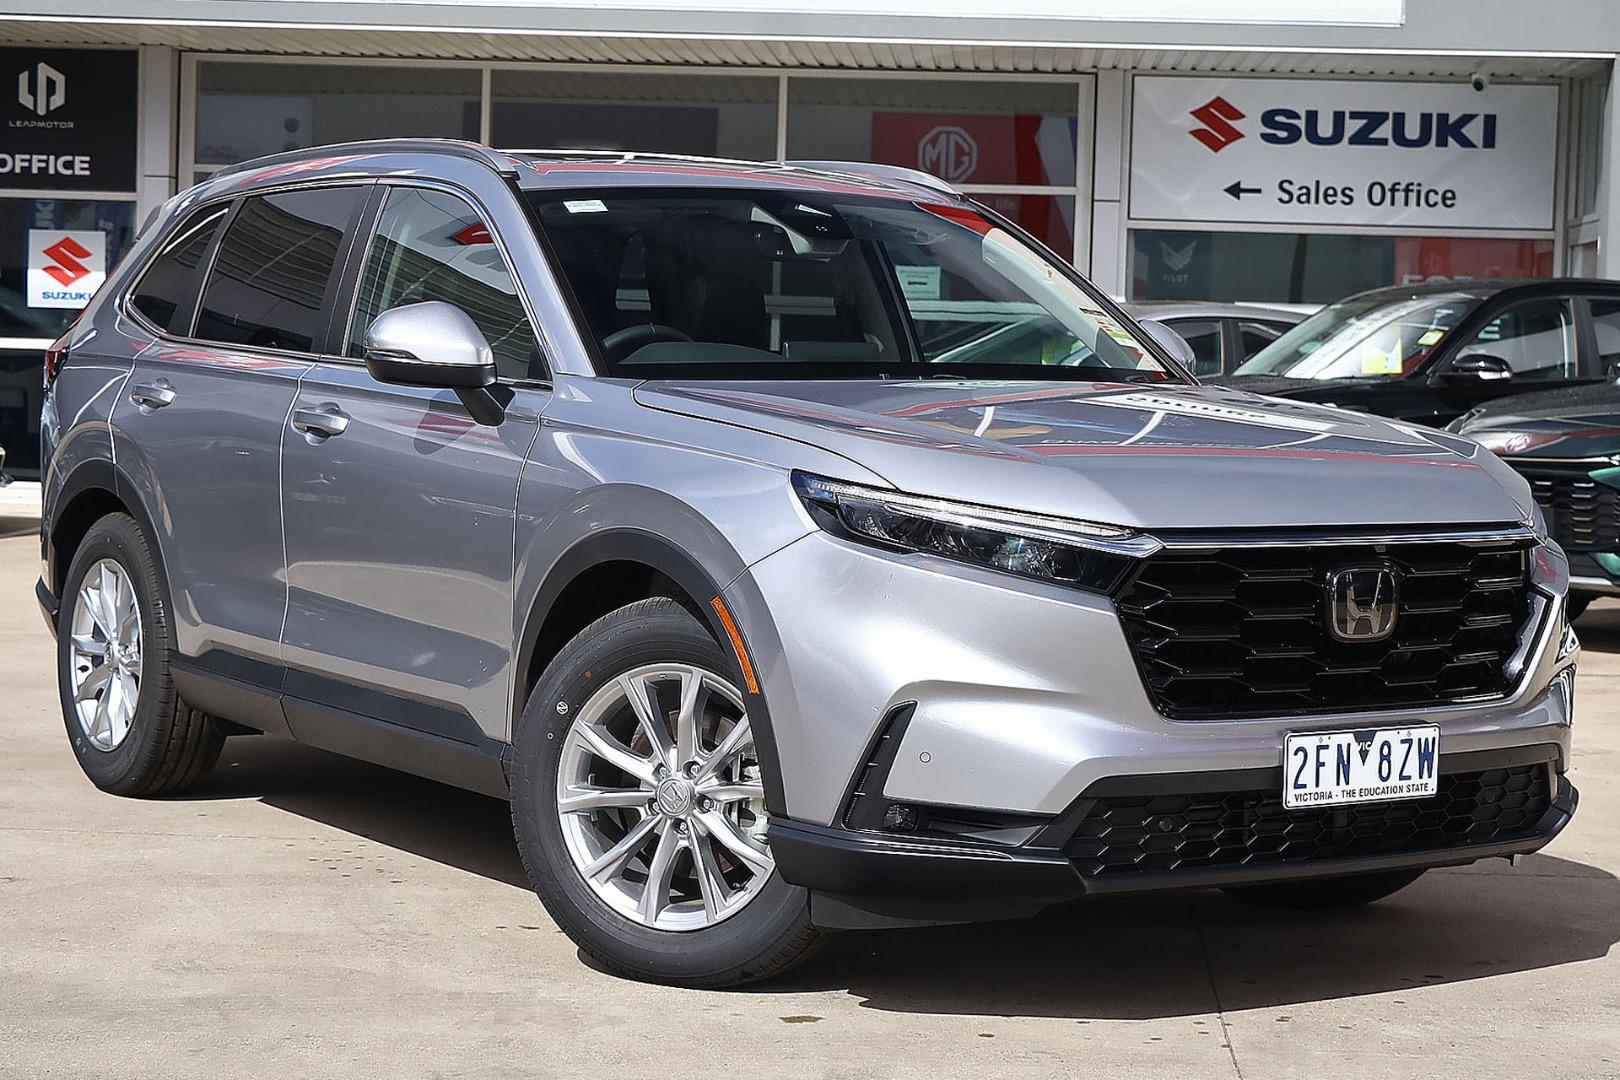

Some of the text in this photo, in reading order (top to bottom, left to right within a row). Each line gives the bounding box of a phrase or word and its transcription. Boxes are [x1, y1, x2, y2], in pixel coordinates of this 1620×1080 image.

[9, 120, 74, 128] LEAPMOTOR
[1259, 108, 1497, 149] SUZUKI
[0, 153, 91, 176] OFFICE
[924, 131, 973, 181] MG
[1277, 179, 1457, 208] Sales Office
[1293, 737, 1436, 789] 2FN 8ZW
[1294, 793, 1333, 803] VICTORIA
[1341, 789, 1356, 799] THE
[1359, 785, 1404, 798] EDUCATION
[1406, 782, 1429, 793] STATE
